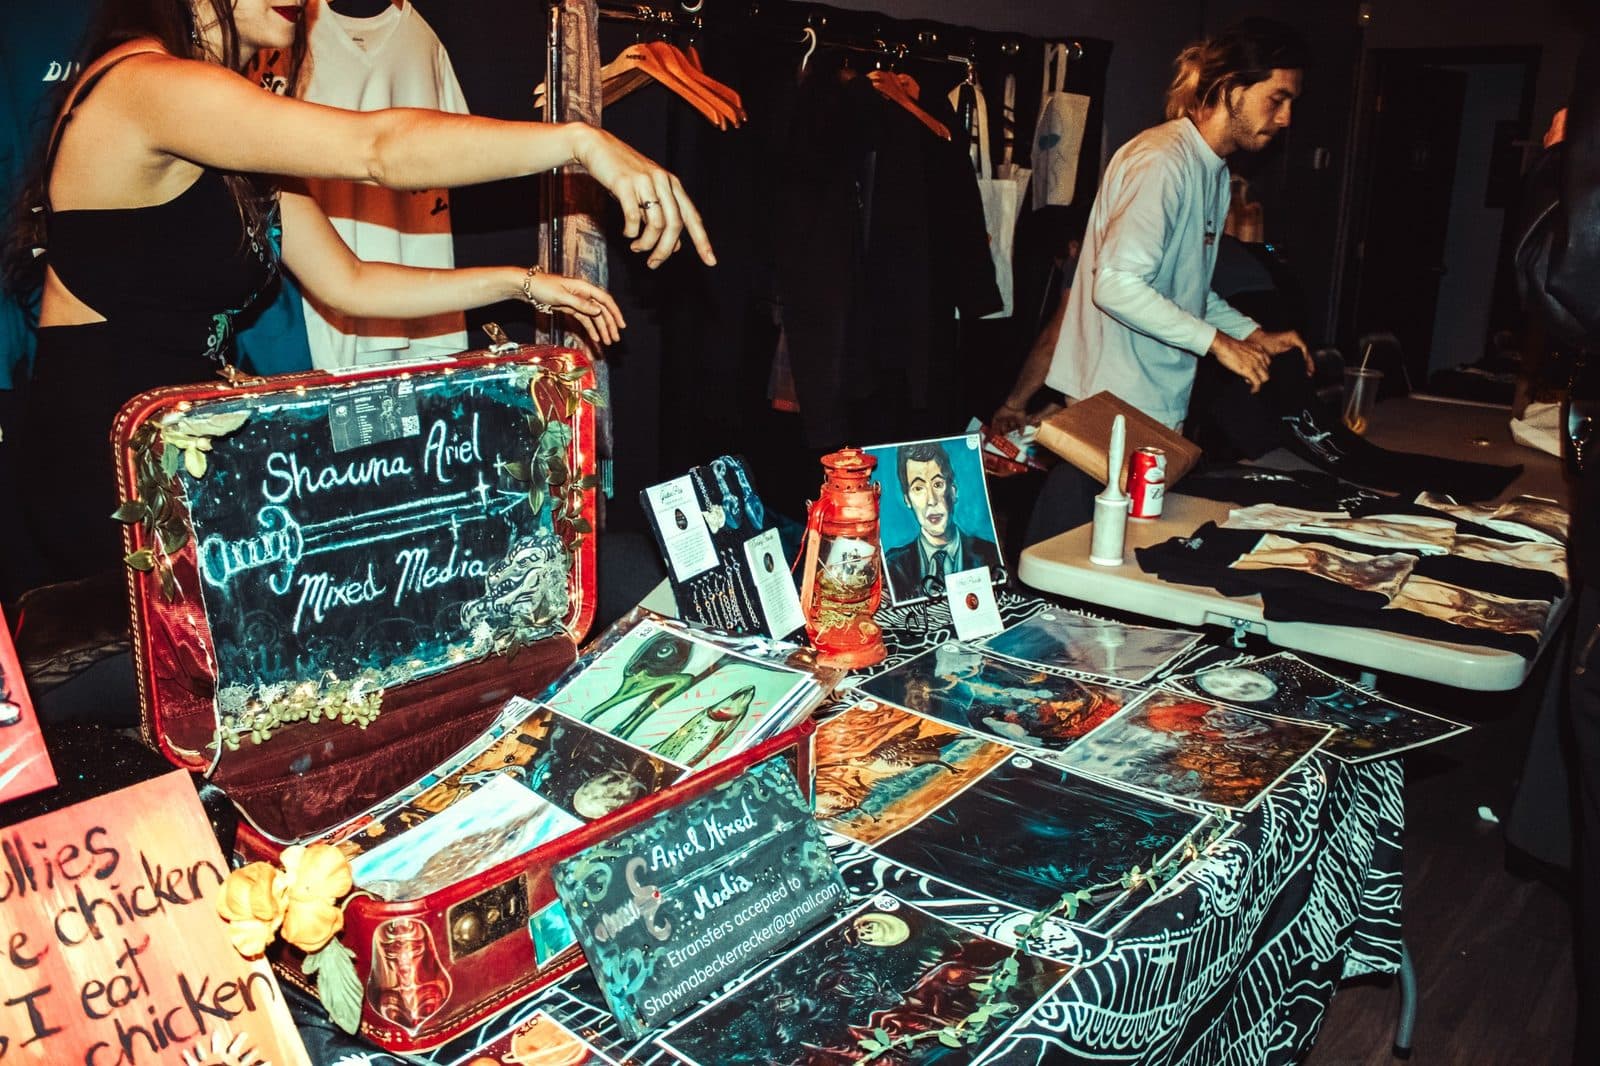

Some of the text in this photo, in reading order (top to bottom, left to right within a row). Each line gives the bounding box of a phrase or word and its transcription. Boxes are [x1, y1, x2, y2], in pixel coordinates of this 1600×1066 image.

[261, 451, 412, 503] Shawna
[424, 413, 484, 483] Ariel
[292, 544, 488, 633] Mixed Media
[651, 795, 758, 871] Ariel Mixed
[54, 850, 224, 947] chicken
[667, 876, 802, 969] Etransfers accepted to
[693, 873, 753, 919] Media
[4, 935, 150, 1048] I eat
[85, 971, 275, 1066] chicken
